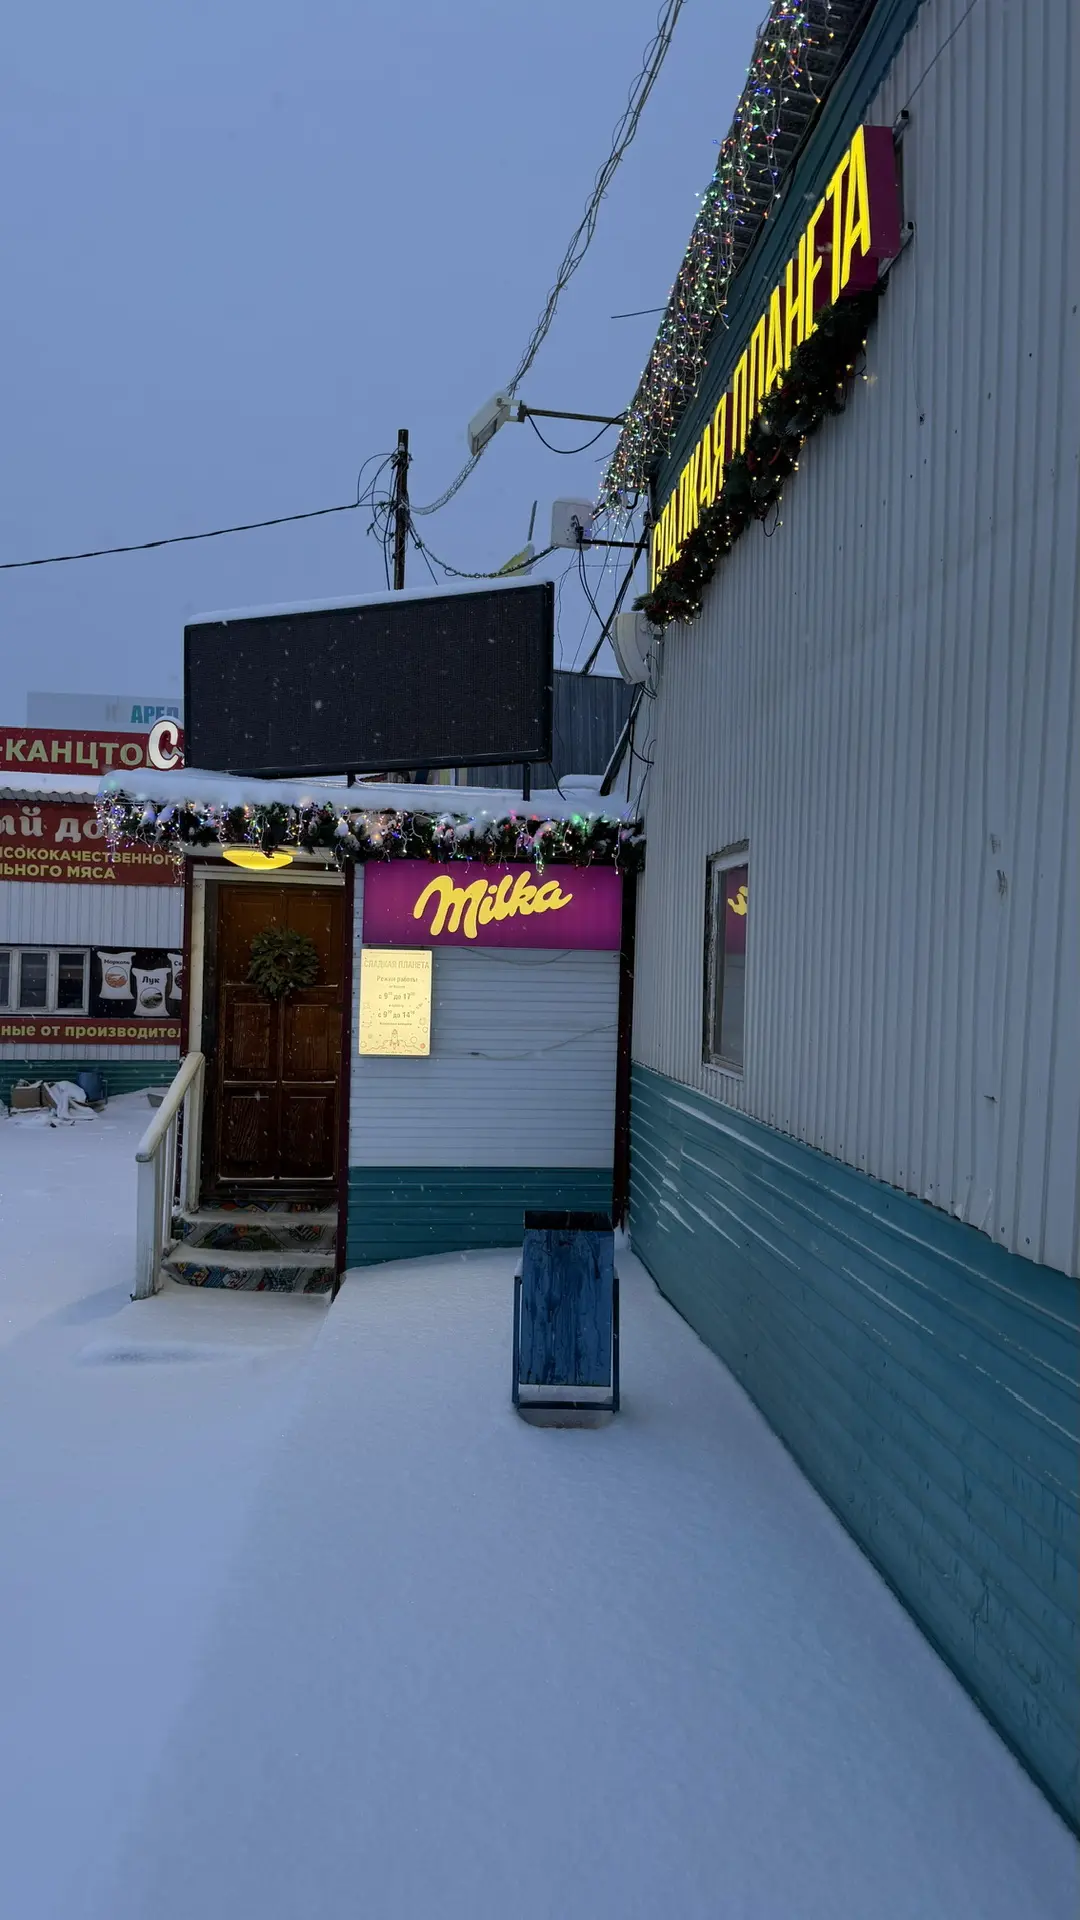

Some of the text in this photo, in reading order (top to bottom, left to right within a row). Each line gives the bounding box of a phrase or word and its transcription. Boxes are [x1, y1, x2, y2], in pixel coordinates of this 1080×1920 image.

[732, 124, 871, 460] ПЛАНЕТА
[0, 738, 153, 769] КАНЦТО
[66, 865, 116, 880] МЯСА
[413, 870, 573, 939] Milka
[141, 976, 160, 984] Лук
[40, 1025, 61, 1036] от
